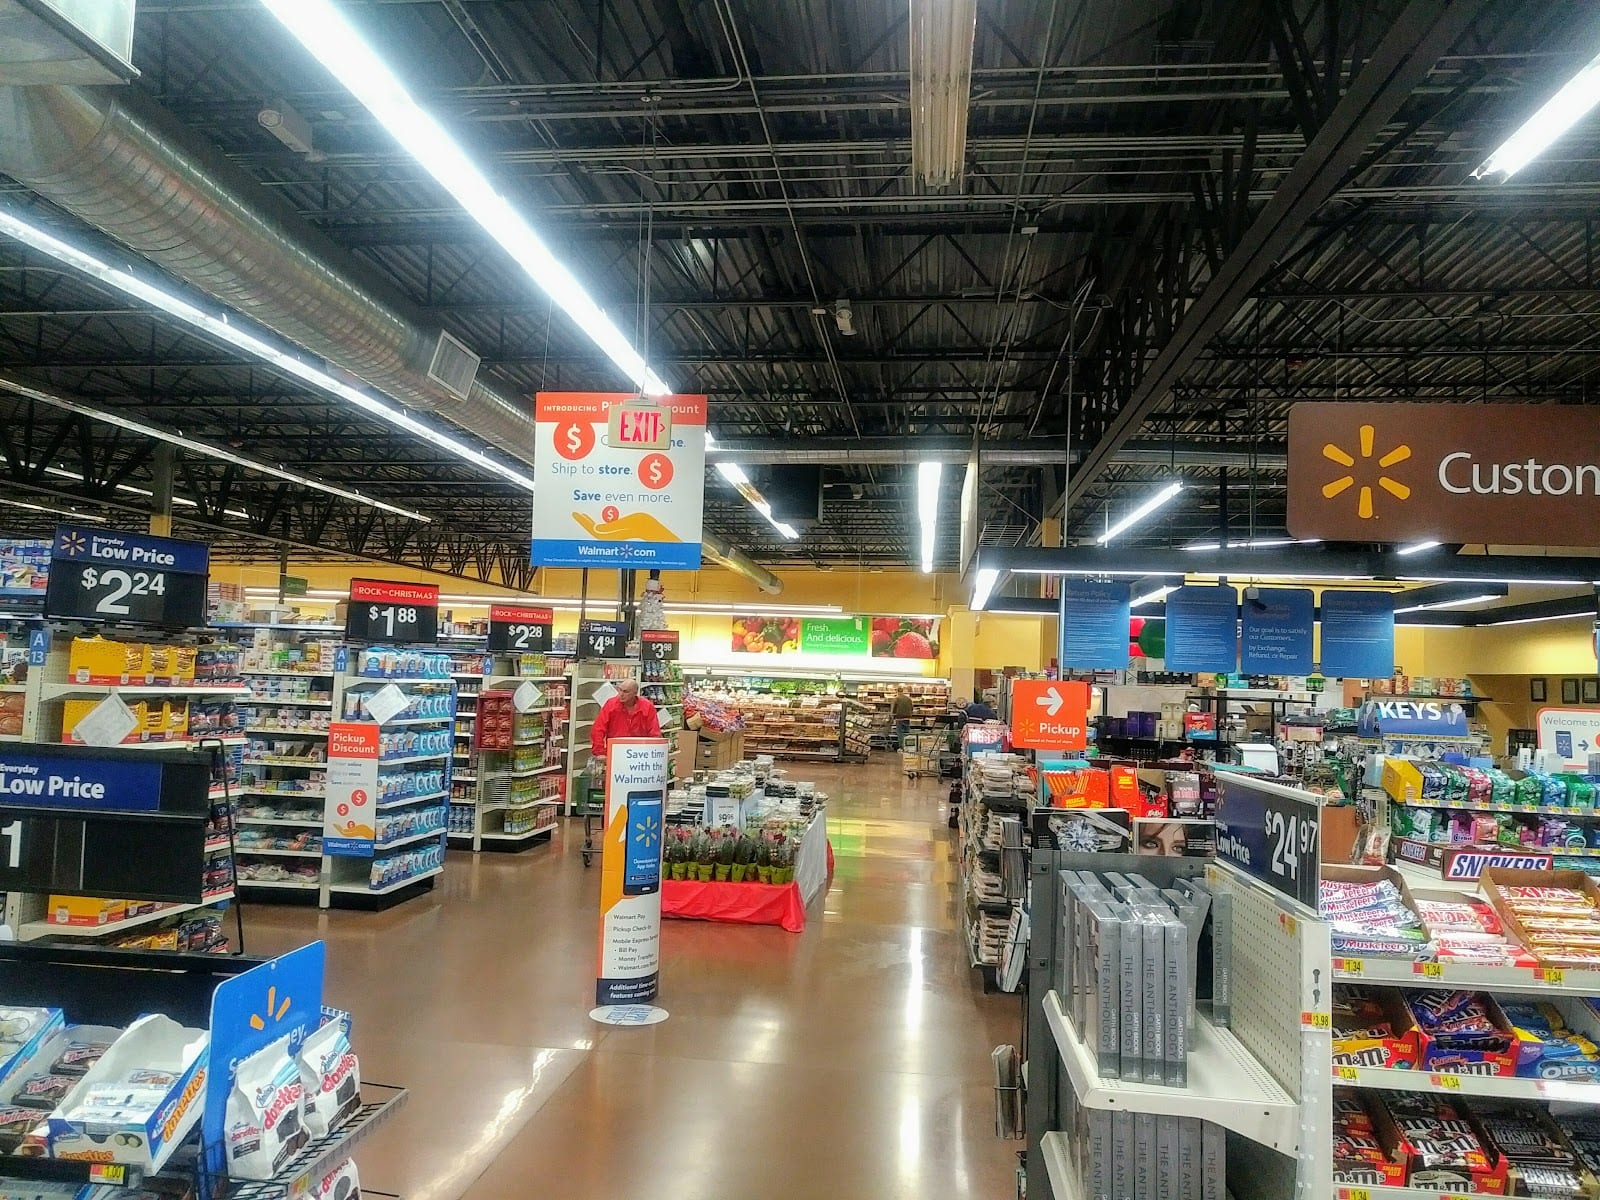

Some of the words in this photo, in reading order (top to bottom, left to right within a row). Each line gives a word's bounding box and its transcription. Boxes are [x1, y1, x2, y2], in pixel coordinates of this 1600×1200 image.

[620, 410, 662, 443] EXIT
[552, 462, 577, 476] Ship
[582, 464, 594, 475] to
[598, 464, 633, 476] store.
[573, 490, 602, 502] Save
[605, 492, 634, 502] even
[638, 494, 673, 504] more.
[92, 536, 125, 546] Everyday
[91, 542, 130, 560] Low
[132, 547, 176, 566] Price
[578, 544, 619, 556] Walmart
[358, 586, 382, 596] ROCK
[388, 589, 433, 600] CHRISTMAS
[32, 632, 44, 646] A
[806, 632, 824, 642] And
[31, 651, 44, 663] 13
[336, 652, 345, 660] A
[1378, 701, 1441, 721] KEYS
[1544, 716, 1588, 726] Welcome
[1040, 722, 1080, 738] Pickup
[333, 732, 366, 745] Pickup
[332, 742, 376, 754] Discount
[626, 748, 648, 760] Save
[651, 748, 664, 758] time
[0, 763, 40, 776] Everyday
[630, 762, 650, 772] with
[0, 772, 46, 795] Low
[48, 774, 105, 799] Price
[614, 774, 654, 784] Walmart
[1231, 835, 1250, 866] Price
[1402, 842, 1426, 860] SNICKERS
[1345, 940, 1408, 951] Musketeers
[1168, 960, 1177, 981] THE
[1542, 1065, 1599, 1078] OREO
[1094, 1136, 1102, 1157] THE
[1115, 1140, 1124, 1160] THE
[1138, 1142, 1146, 1160] THE
[1160, 1144, 1168, 1166] THE
[1182, 1146, 1192, 1168] THE
[1208, 1150, 1216, 1174] THE
